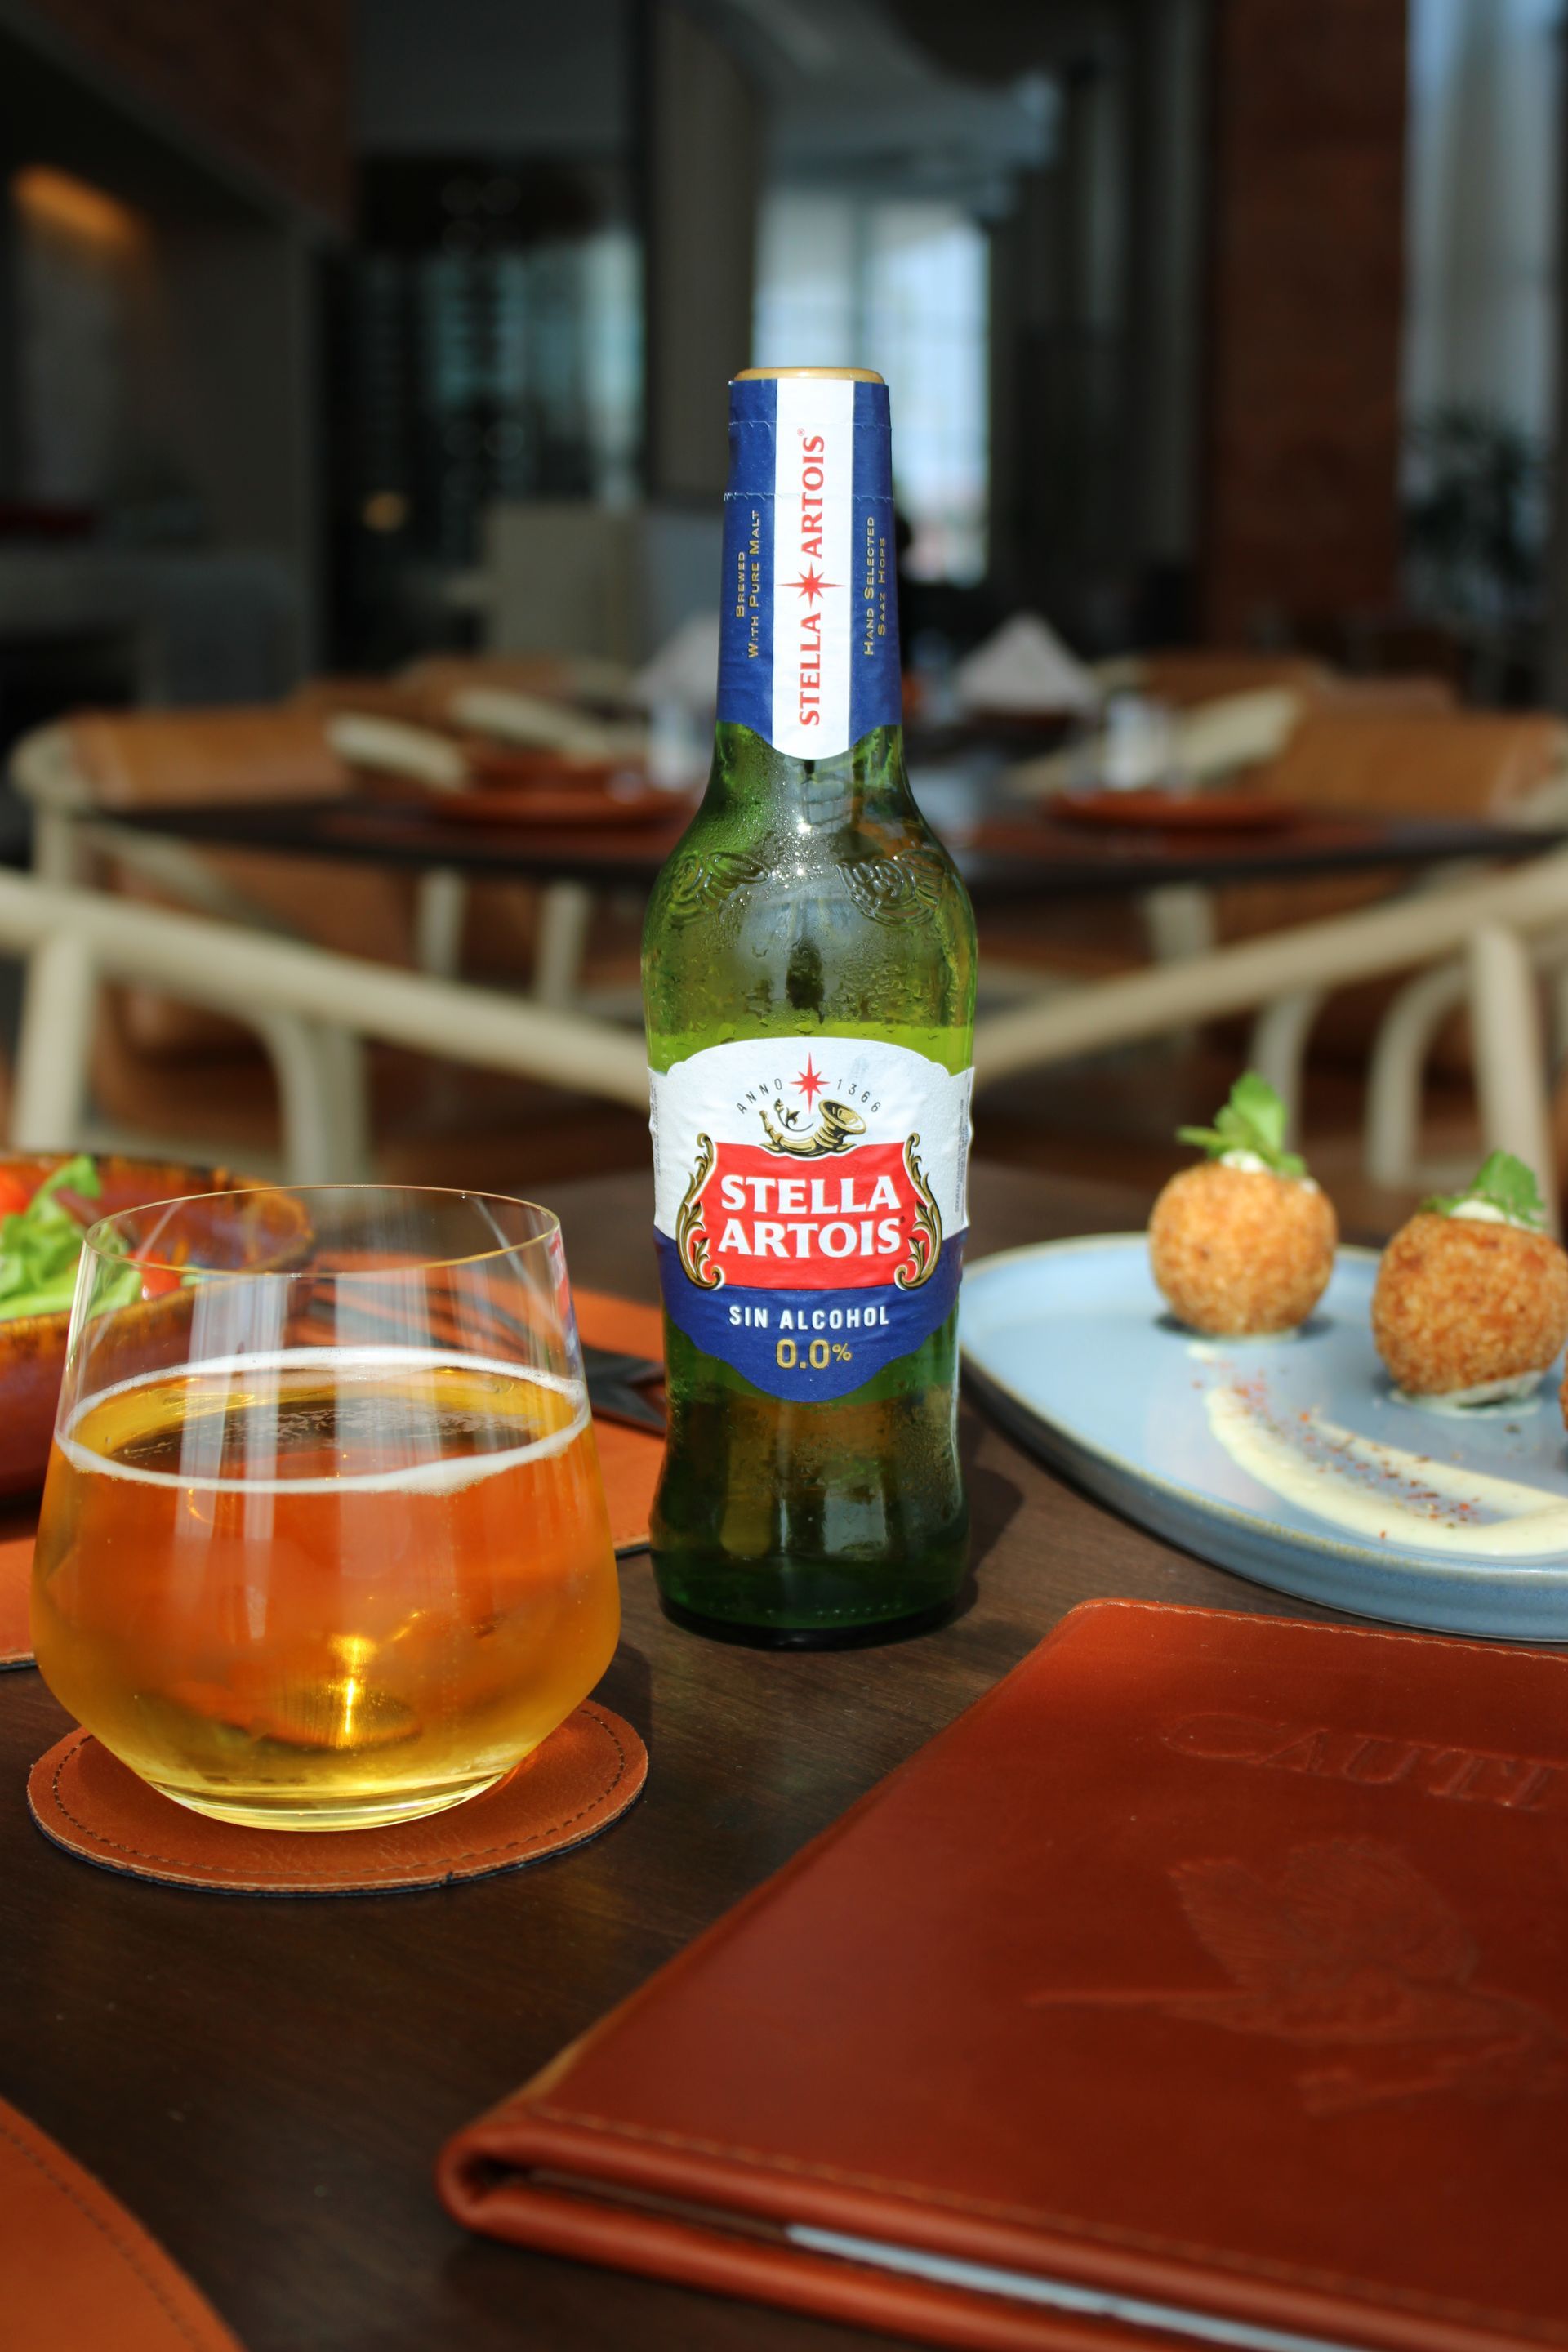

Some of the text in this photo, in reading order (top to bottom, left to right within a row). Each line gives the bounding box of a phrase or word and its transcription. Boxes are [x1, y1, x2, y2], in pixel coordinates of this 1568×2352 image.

[799, 612, 821, 726] STELLA
[737, 1078, 881, 1115] ANNO 1366
[720, 1174, 901, 1214] STELLA
[718, 1218, 902, 1258] ARTOIS
[729, 1306, 889, 1330] SIN ALCOHOL
[777, 1339, 852, 1369] 0.0%
